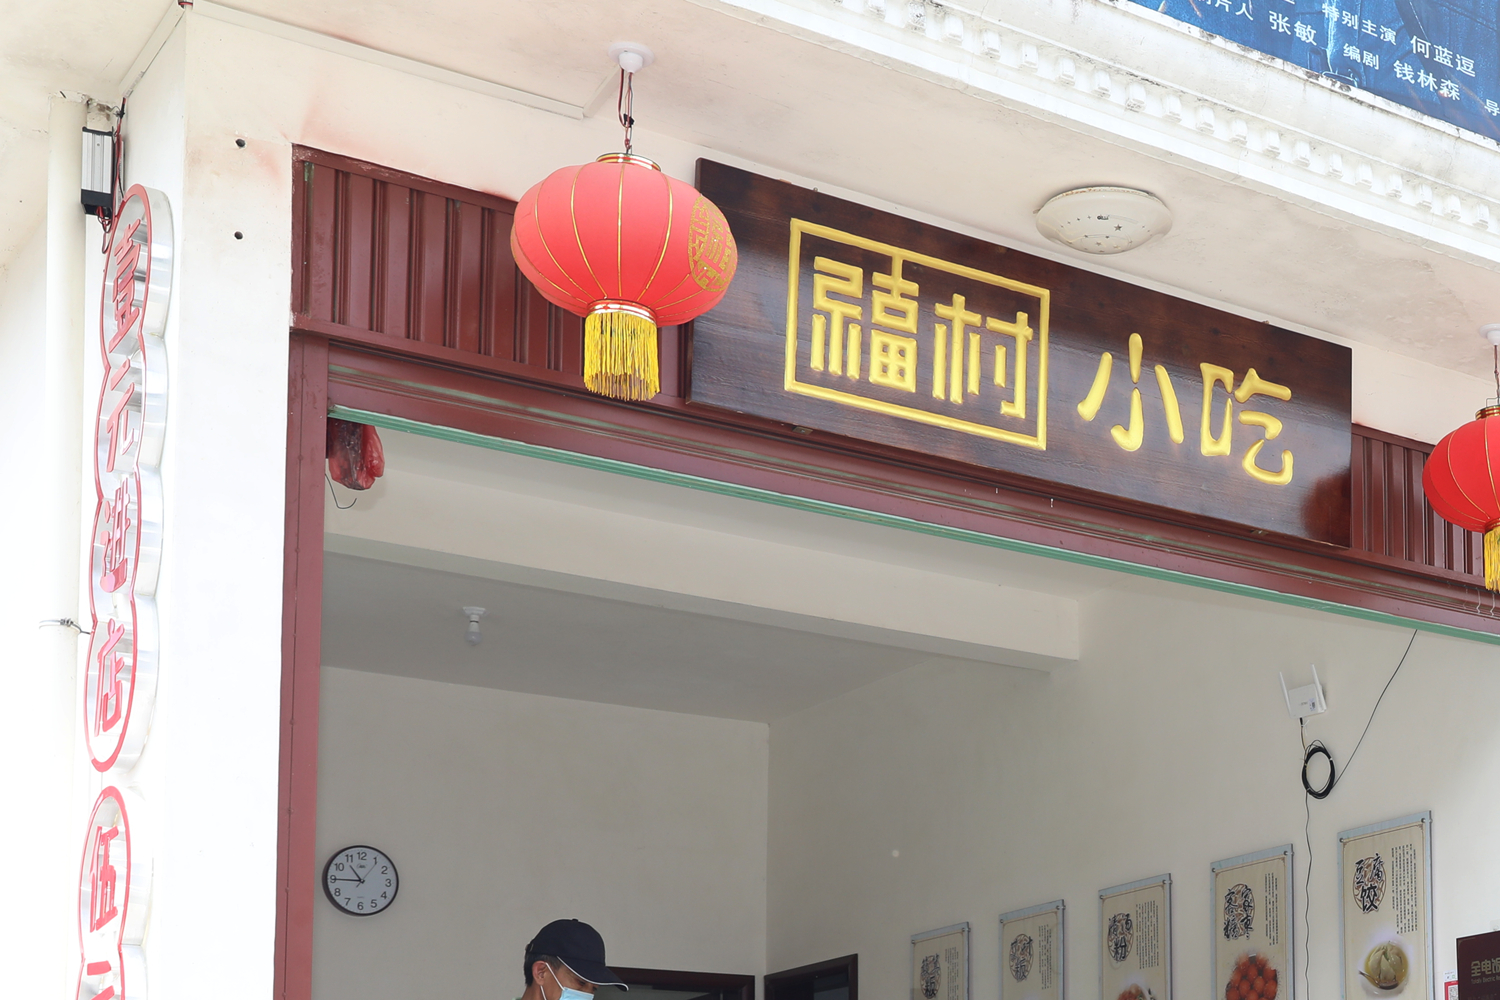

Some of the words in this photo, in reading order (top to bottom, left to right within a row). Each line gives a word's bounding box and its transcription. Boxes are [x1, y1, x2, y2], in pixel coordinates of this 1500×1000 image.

[1321, 3, 1397, 45] 特别主演
[1410, 35, 1476, 77] 何蓝逗
[1206, 0, 1254, 21] 片人
[1268, 10, 1317, 46] 张敏
[1342, 43, 1380, 70] 编剧
[1393, 60, 1461, 101] 钱林森
[810, 247, 1034, 419] 福村
[1076, 332, 1296, 487] 小吃
[94, 217, 142, 738] 壹元进店
[345, 854, 354, 863] 11
[356, 851, 367, 861] 12
[373, 856, 378, 865] 1
[334, 862, 345, 872] 10
[381, 865, 388, 875] 2
[329, 874, 337, 883] 9
[385, 878, 392, 887] 3
[334, 887, 341, 897] 8
[380, 891, 387, 900] 4
[344, 897, 351, 906] 7
[357, 901, 364, 911] 6
[370, 899, 378, 908] 5
